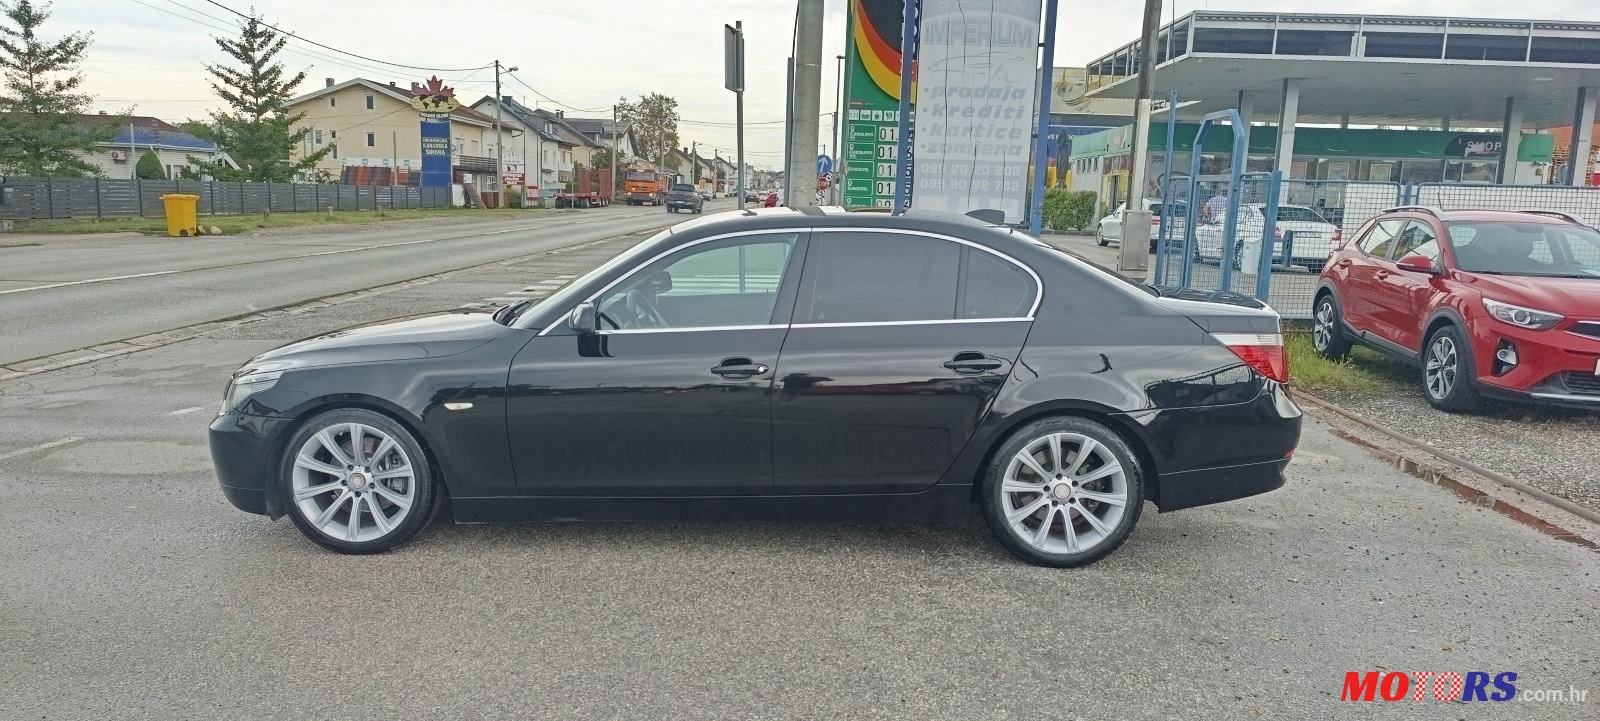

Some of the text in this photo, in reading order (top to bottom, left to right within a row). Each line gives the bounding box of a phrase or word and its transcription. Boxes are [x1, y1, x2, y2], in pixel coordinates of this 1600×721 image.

[924, 19, 1034, 48] IMPERIUM
[930, 85, 1025, 102] prodaja
[930, 103, 1025, 119] krediti
[929, 122, 1024, 139] kartice
[926, 141, 1023, 157] zamjena
